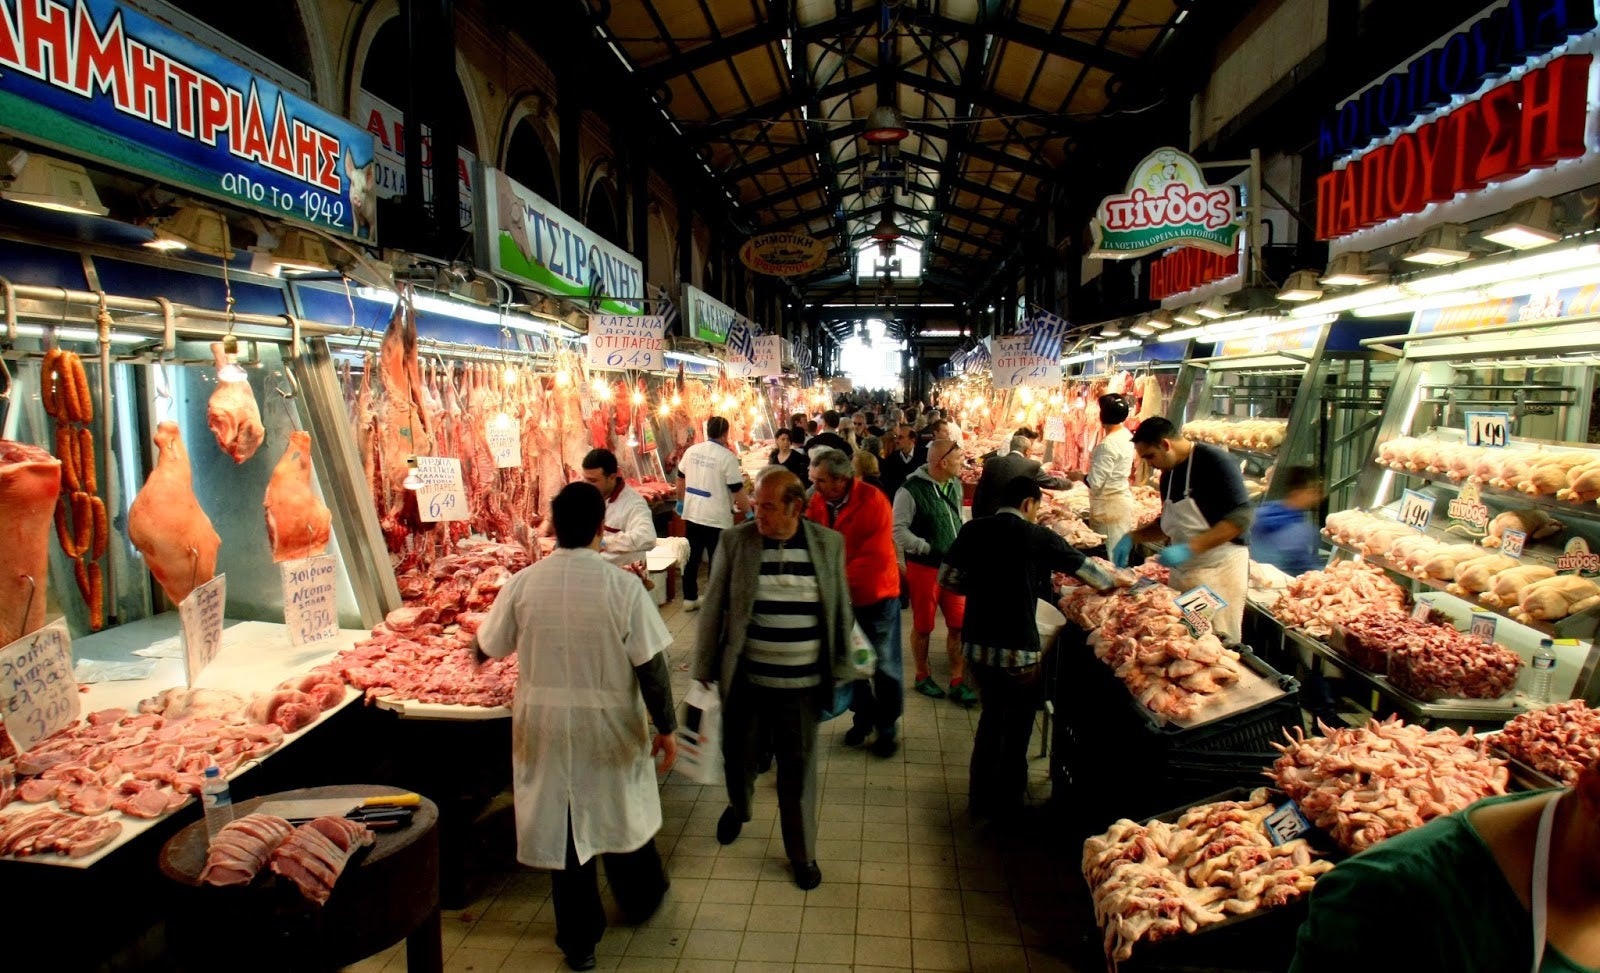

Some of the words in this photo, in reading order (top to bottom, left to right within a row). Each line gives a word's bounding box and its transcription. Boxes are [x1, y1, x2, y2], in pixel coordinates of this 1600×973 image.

[1315, 54, 1584, 241] ΠΑΠΟΥΤΣΗ
[221, 172, 265, 202] απο
[272, 186, 294, 212] το
[299, 189, 345, 229] 1942
[1149, 230, 1179, 245] ΟΡΕΙΝΑ
[600, 315, 662, 329] ΚΑΤΣΙΚΙΑ
[600, 328, 653, 338] ΑΡΝΙΑ
[606, 348, 651, 367] 6,49
